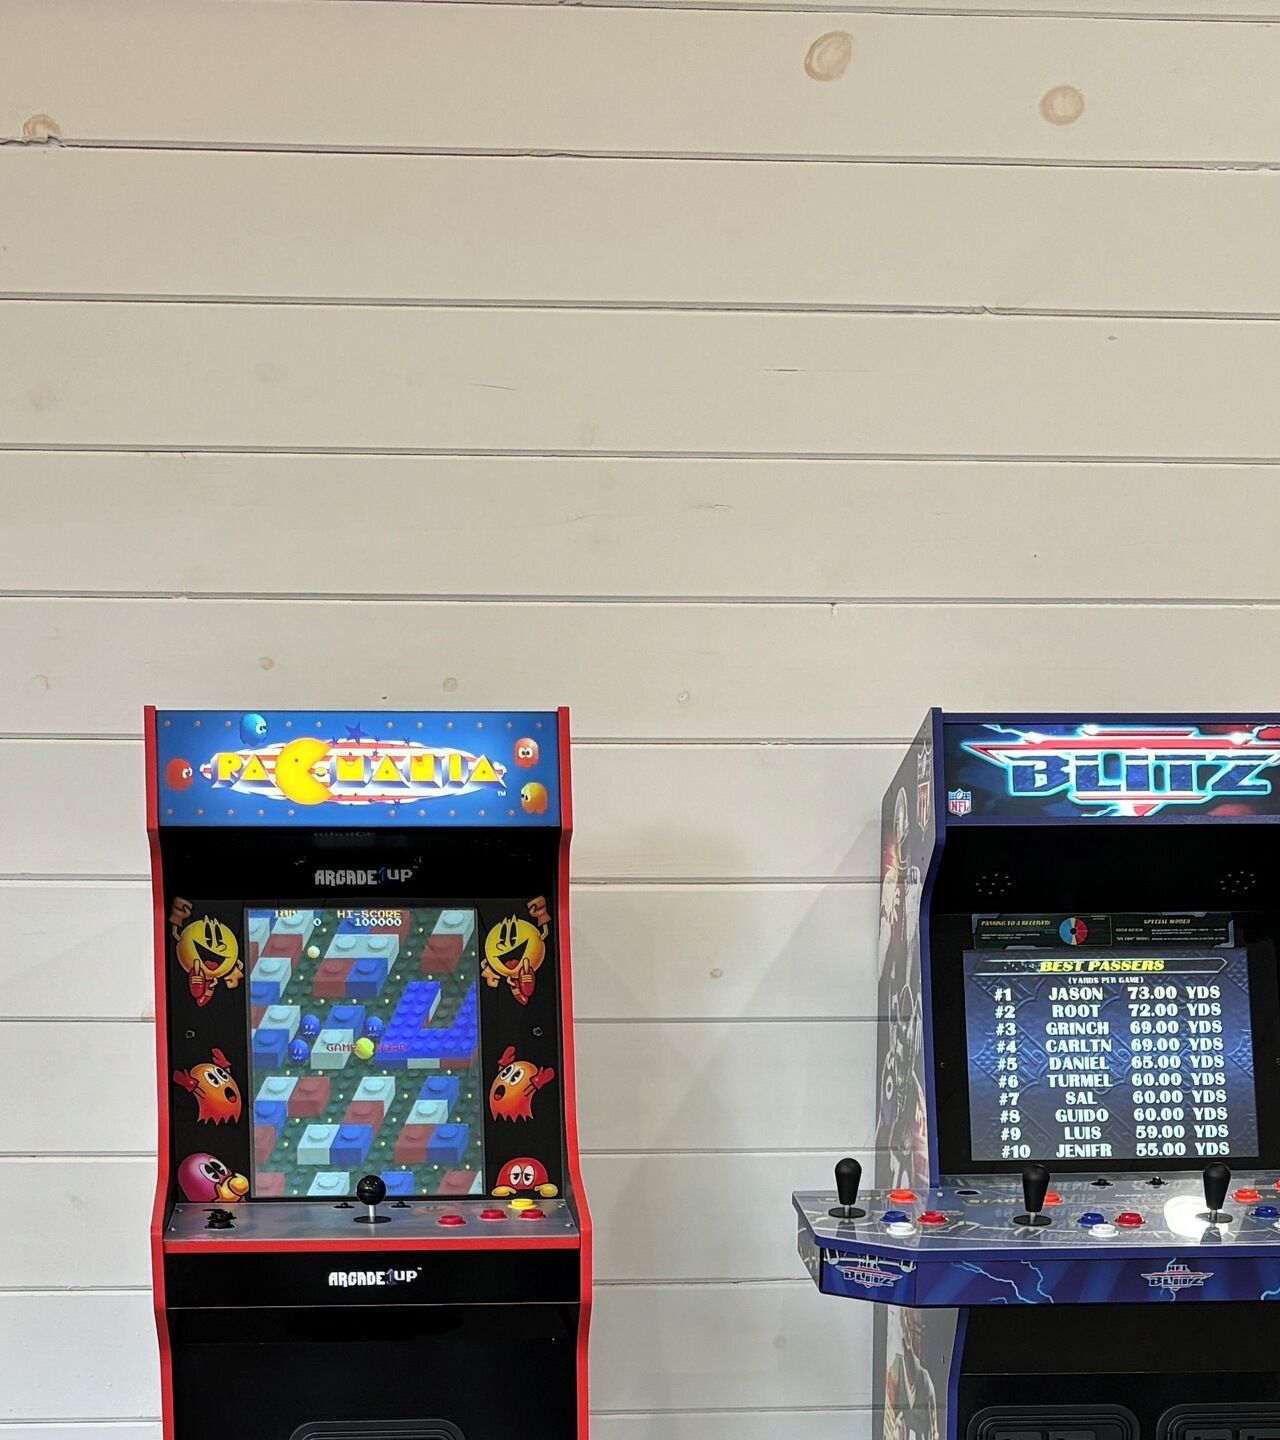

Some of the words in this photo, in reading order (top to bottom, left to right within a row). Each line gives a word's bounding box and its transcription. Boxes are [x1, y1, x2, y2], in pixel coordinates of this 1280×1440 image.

[1009, 750, 1272, 796] BLITZ
[951, 800, 970, 813] NFL
[337, 910, 401, 918] HI-SCORE
[355, 918, 402, 926] 100000
[1040, 961, 1084, 972] BEST
[1087, 960, 1165, 972] PASSERS
[994, 987, 1012, 1001] #1
[1048, 987, 1103, 1001] JASON
[1127, 986, 1177, 999] 73.00
[1186, 985, 1220, 999] YDS
[995, 1005, 1015, 1018] #2
[1052, 1004, 1101, 1017] ROOT
[1128, 1003, 1178, 1017] 72.00
[1187, 1003, 1221, 1016] YDS
[995, 1022, 1016, 1036] #3
[1046, 1022, 1109, 1035] GRINCH
[1130, 1021, 1179, 1034] 69.00
[1188, 1020, 1223, 1033] YDS
[996, 1040, 1017, 1053] #4
[1046, 1039, 1111, 1053] CARLTN
[1131, 1038, 1180, 1051] 69.00
[1189, 1037, 1223, 1051] YDS
[997, 1057, 1018, 1071] #5
[1049, 1056, 1109, 1070] DANIEL
[1131, 1055, 1181, 1069] 65.00
[1190, 1055, 1224, 1068] YDS
[999, 1075, 1019, 1088] #6
[1047, 1074, 1113, 1087] TURMEL
[1132, 1072, 1182, 1086] 60.00
[1191, 1072, 1225, 1086] YDS
[999, 1092, 1019, 1106] #7
[1065, 1091, 1098, 1105] SAL
[1132, 1090, 1183, 1104] 60.00
[1192, 1089, 1227, 1103] YDS
[1000, 1110, 1020, 1123] #8
[1055, 1108, 1109, 1122] GUIDO
[1133, 1107, 1184, 1121] 60.00
[1193, 1107, 1228, 1120] YDS
[1001, 1127, 1021, 1141] #9
[1064, 1126, 1102, 1140] LUIS
[1136, 1125, 1185, 1138] 59.00
[1194, 1124, 1229, 1138] YDS
[1001, 1145, 1031, 1158] #10
[1056, 1143, 1112, 1158] JENIFR
[1136, 1142, 1186, 1156] 55.00
[1195, 1142, 1230, 1156] YDS
[328, 1268, 418, 1288] ARCADE1UP
